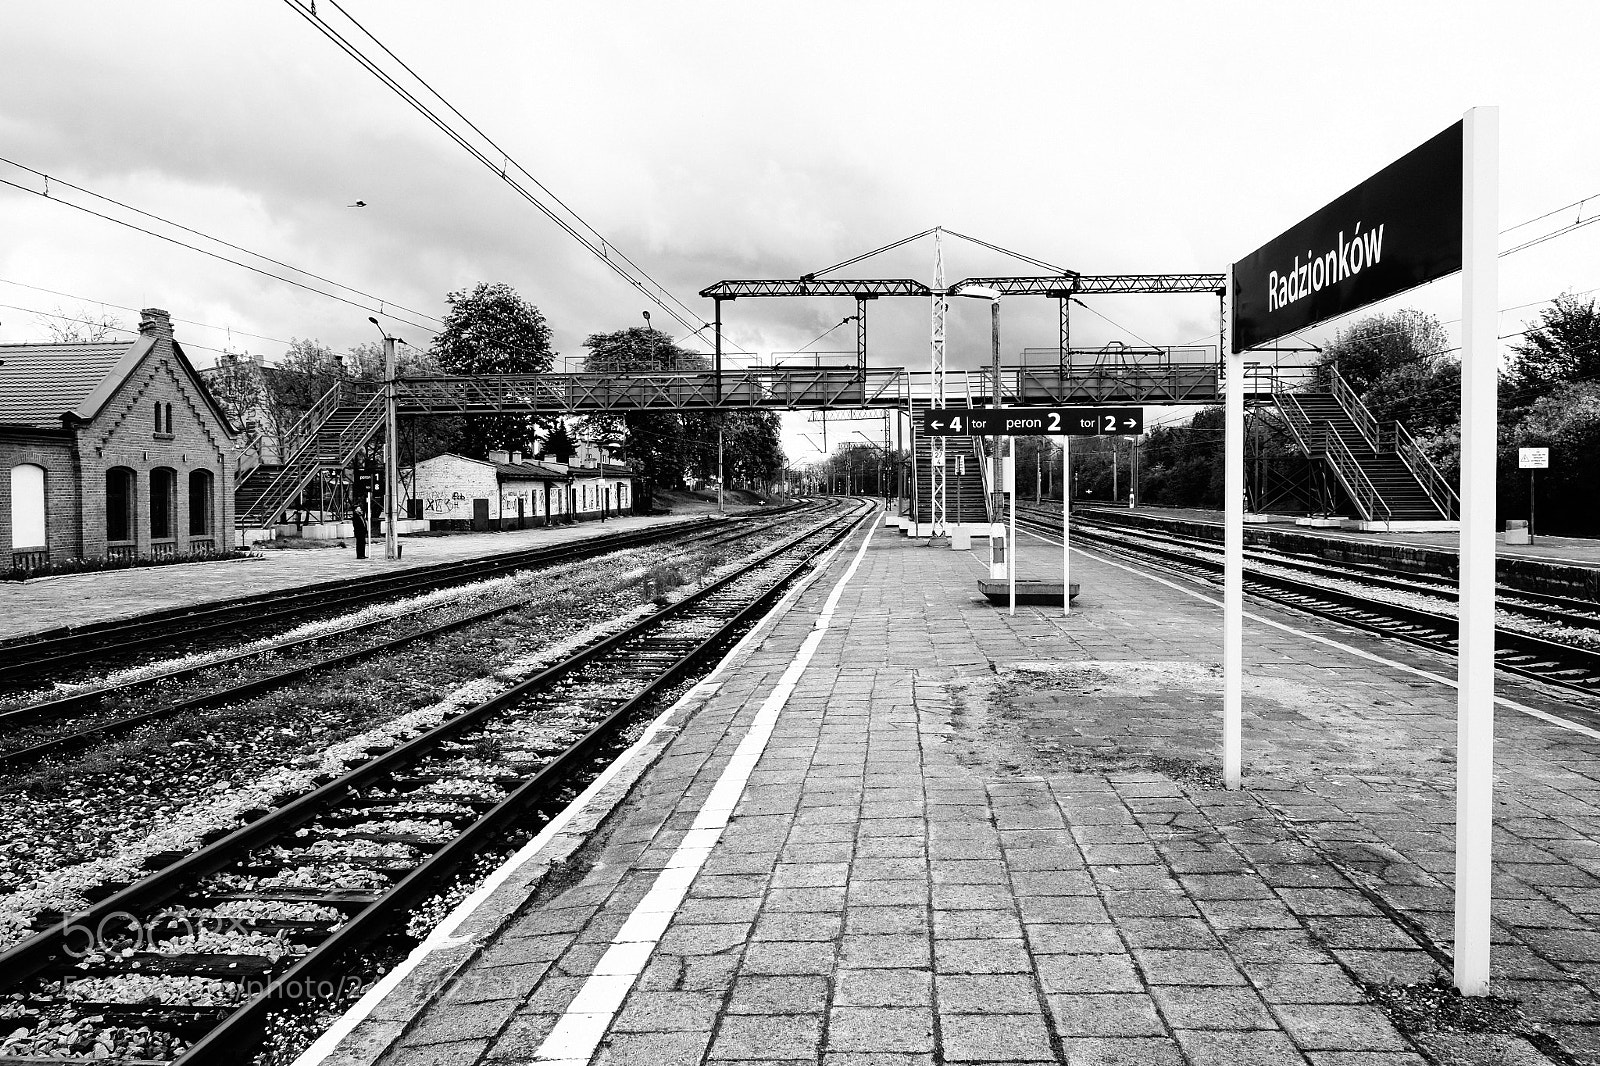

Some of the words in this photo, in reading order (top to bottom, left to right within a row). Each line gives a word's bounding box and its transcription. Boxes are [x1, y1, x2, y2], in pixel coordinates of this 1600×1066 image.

[1268, 220, 1385, 313] Radzionków
[949, 416, 963, 432] 4
[971, 419, 987, 429] tor
[1006, 419, 1042, 431] peron
[1047, 412, 1062, 432] 2
[1080, 418, 1096, 428] tor
[1104, 415, 1117, 432] 2
[374, 473, 379, 481] 1
